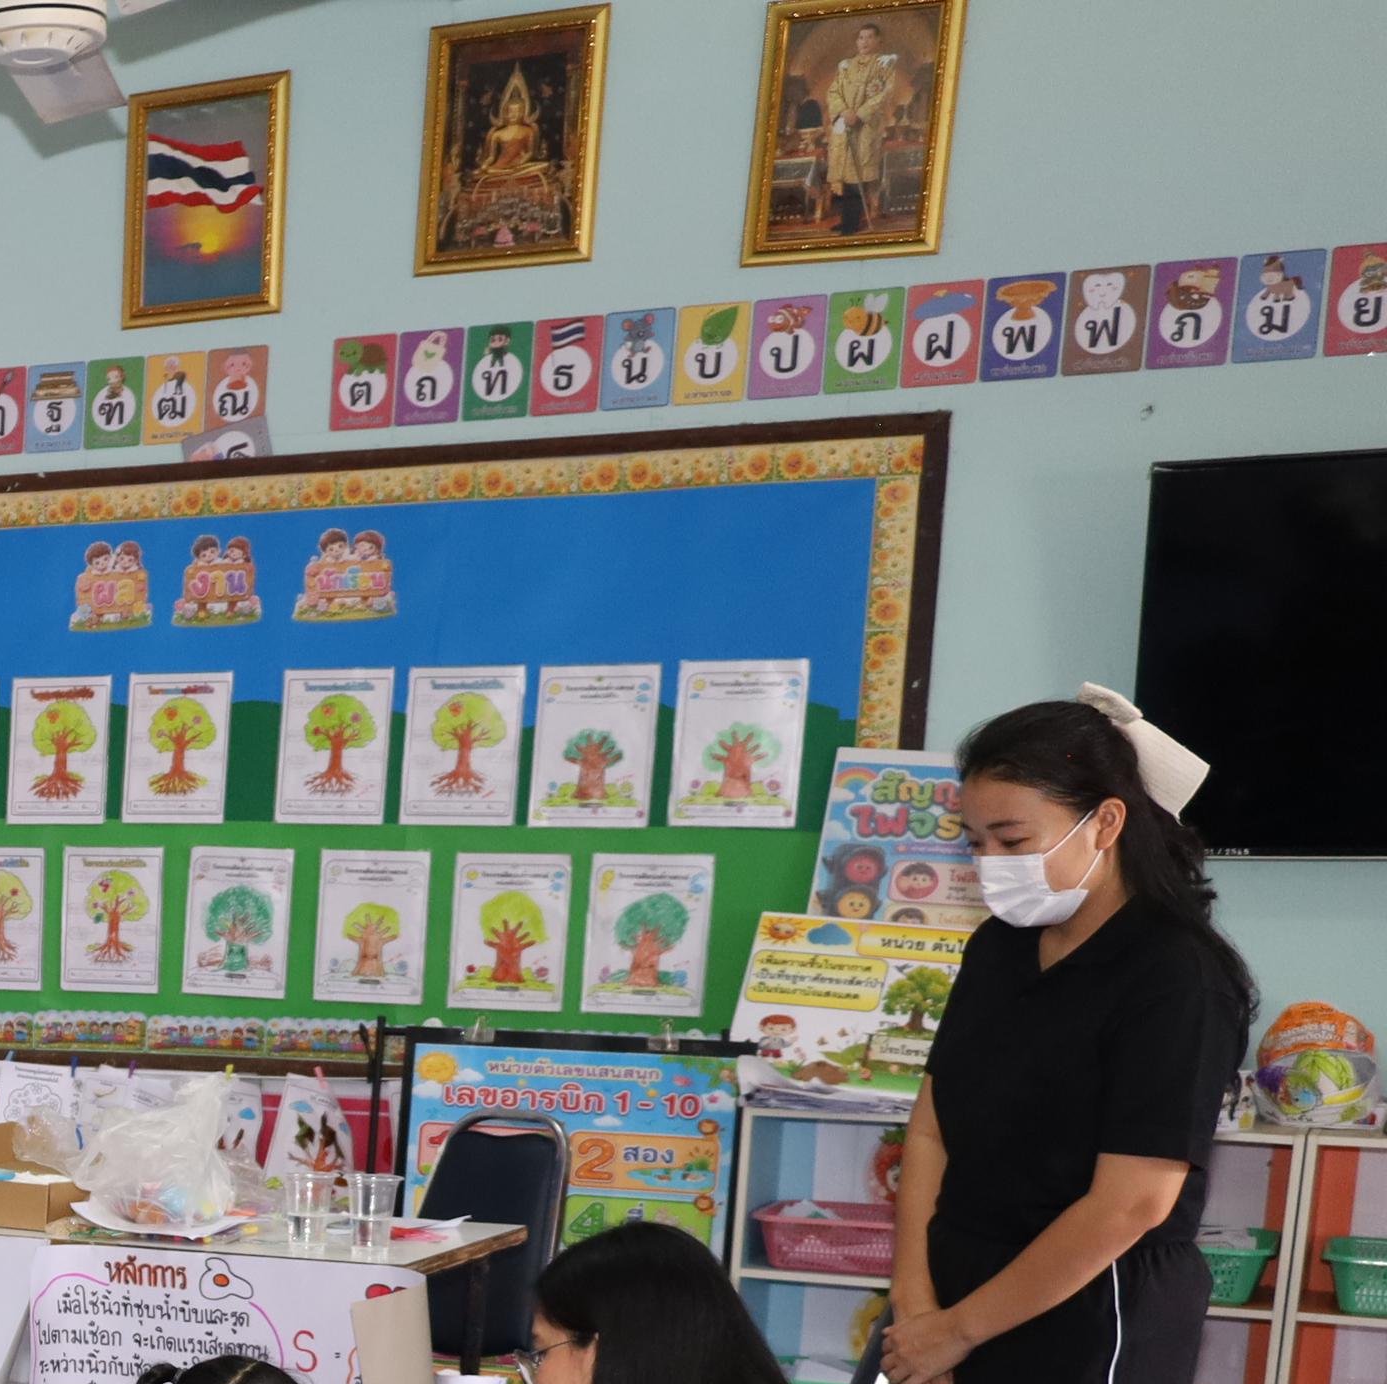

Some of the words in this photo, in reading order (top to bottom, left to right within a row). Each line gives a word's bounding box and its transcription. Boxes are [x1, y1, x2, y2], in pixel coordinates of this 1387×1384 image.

[1086, 307, 1119, 347] ฟ
[1260, 307, 1291, 334] ม
[1353, 301, 1379, 326] ย
[927, 321, 955, 361] ฝ
[1003, 328, 1035, 353] พ
[1170, 317, 1199, 342] ภ
[696, 353, 721, 379] บ
[771, 336, 798, 374] ป
[848, 340, 874, 366] ผ
[481, 370, 507, 395] ท
[553, 364, 574, 391] ธ
[623, 359, 647, 384] น
[349, 379, 371, 406] ต
[415, 375, 436, 401] ถ
[100, 399, 125, 427] ฑ
[158, 396, 186, 422] ฒ
[218, 390, 249, 417] ณ
[46, 403, 62, 434] ฐ
[94, 580, 135, 604] ผล
[190, 572, 246, 597] งาน
[316, 567, 385, 590] นักเรียน
[872, 771, 962, 812] สัญญ
[849, 805, 962, 839] ไฟจร
[880, 936, 925, 950] หน่วย
[932, 938, 965, 953] ต้นไ
[488, 1060, 661, 1087] หน่วยตัวเลขแสนสนุก
[444, 1082, 605, 1114] เลขอารบิก
[614, 1092, 632, 1115] 1
[665, 1094, 702, 1118] 10
[575, 1138, 614, 1181] 2
[623, 1145, 674, 1164] สอง
[568, 1203, 605, 1236] 4
[105, 1256, 187, 1290] หลักการ
[293, 1331, 317, 1372] S
